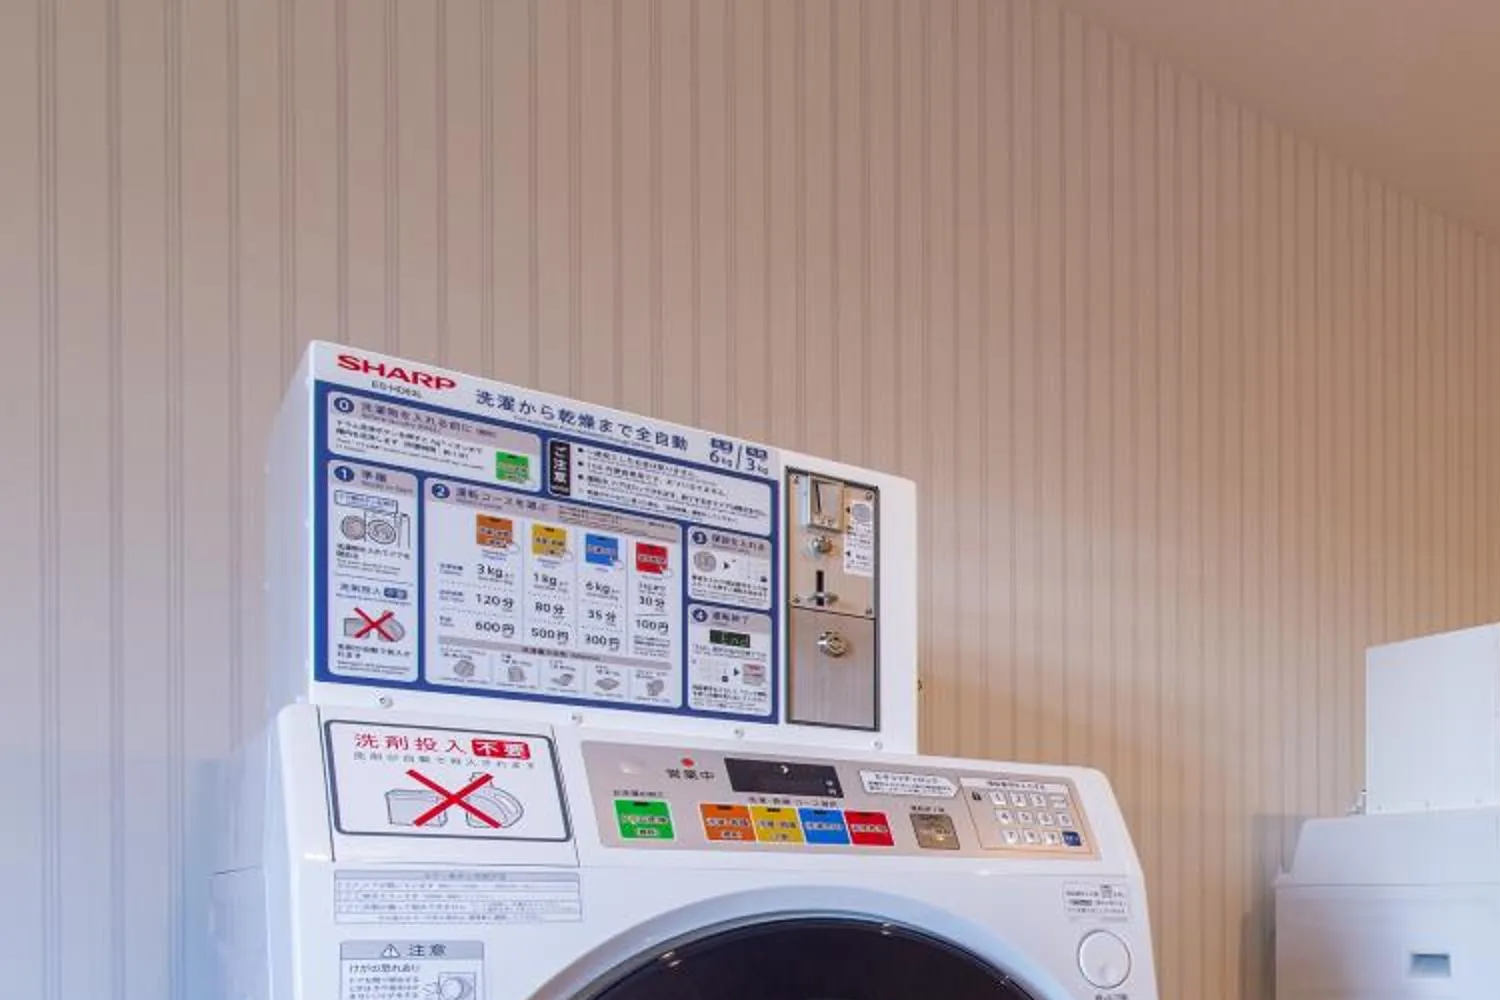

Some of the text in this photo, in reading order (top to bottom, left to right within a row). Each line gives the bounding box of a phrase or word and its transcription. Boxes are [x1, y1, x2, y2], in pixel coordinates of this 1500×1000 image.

[337, 354, 457, 391] SHARP
[475, 389, 688, 452] 洗濯から乾燥まで全自動
[354, 732, 467, 755] 洗剤投入
[666, 769, 715, 781] 営業中
[408, 944, 446, 957] 注意
